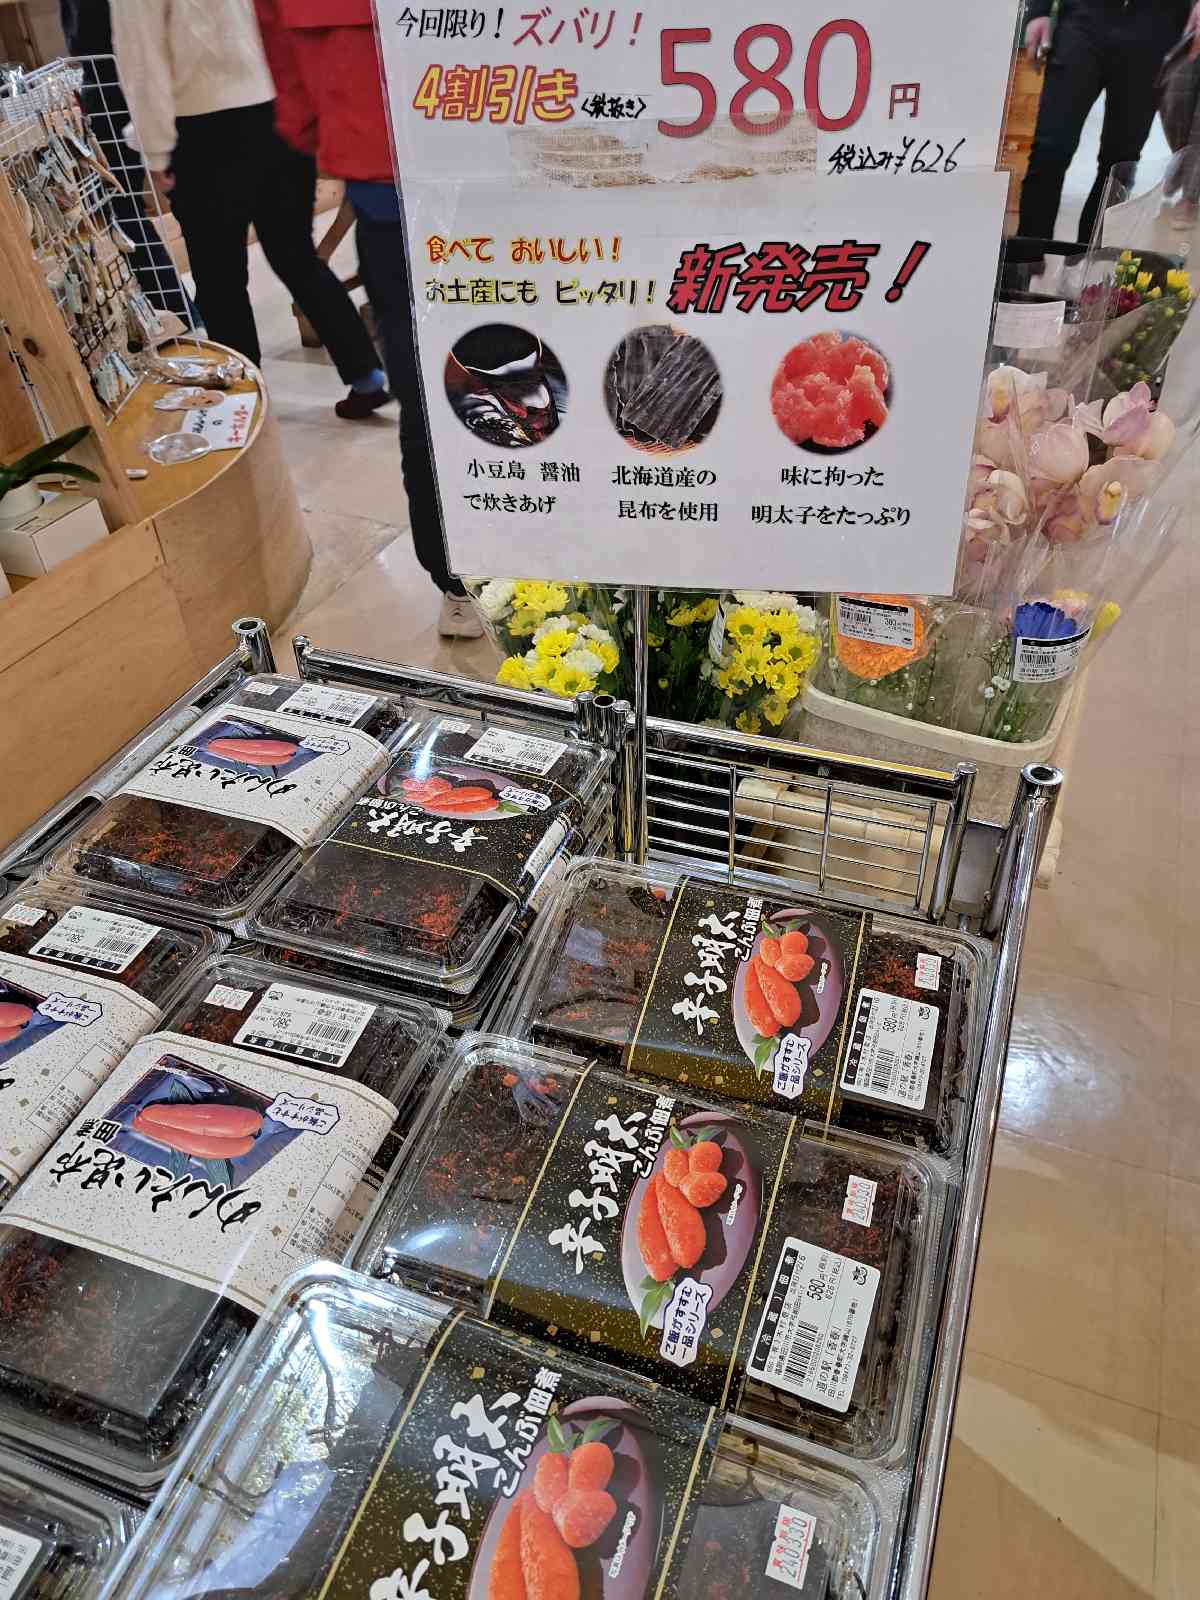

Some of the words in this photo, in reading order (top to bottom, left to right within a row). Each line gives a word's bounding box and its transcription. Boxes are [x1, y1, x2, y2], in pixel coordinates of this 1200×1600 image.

[396, 7, 504, 38] 今回限り！
[513, 7, 642, 49] ズバリ！
[413, 63, 578, 124] 4割引き
[656, 19, 872, 139] 580
[888, 82, 921, 120] 円
[427, 235, 493, 263] 食べて
[511, 236, 621, 263] おいしい！
[425, 277, 538, 305] お土産にも
[556, 278, 656, 304] ピッタリ！
[666, 240, 932, 315] 新発売！
[466, 458, 526, 480] 小豆島
[611, 465, 717, 489] 北海道産の
[780, 465, 885, 488] 味に拘った
[464, 493, 557, 514] で炊きあげ
[617, 500, 719, 522] 昆布を使用
[751, 503, 911, 527] 明太子をたっぷり
[150, 755, 298, 798] めんたい昆布
[367, 809, 488, 852] 辛子明太
[735, 896, 764, 961] こんぶ佃煮
[672, 911, 741, 1035] 辛子明太
[77, 1118, 120, 1143] 佃煮
[633, 1095, 676, 1178] こんぶ佃煮
[50, 1141, 261, 1233] めんたい昆布
[548, 1111, 647, 1275] 辛子明太
[666, 1285, 693, 1356] ご飯がすすむ
[680, 1290, 709, 1359] 一品シリーズ
[493, 1367, 562, 1496] こんぶ佃煮
[369, 1392, 521, 1600] 辛子明太
